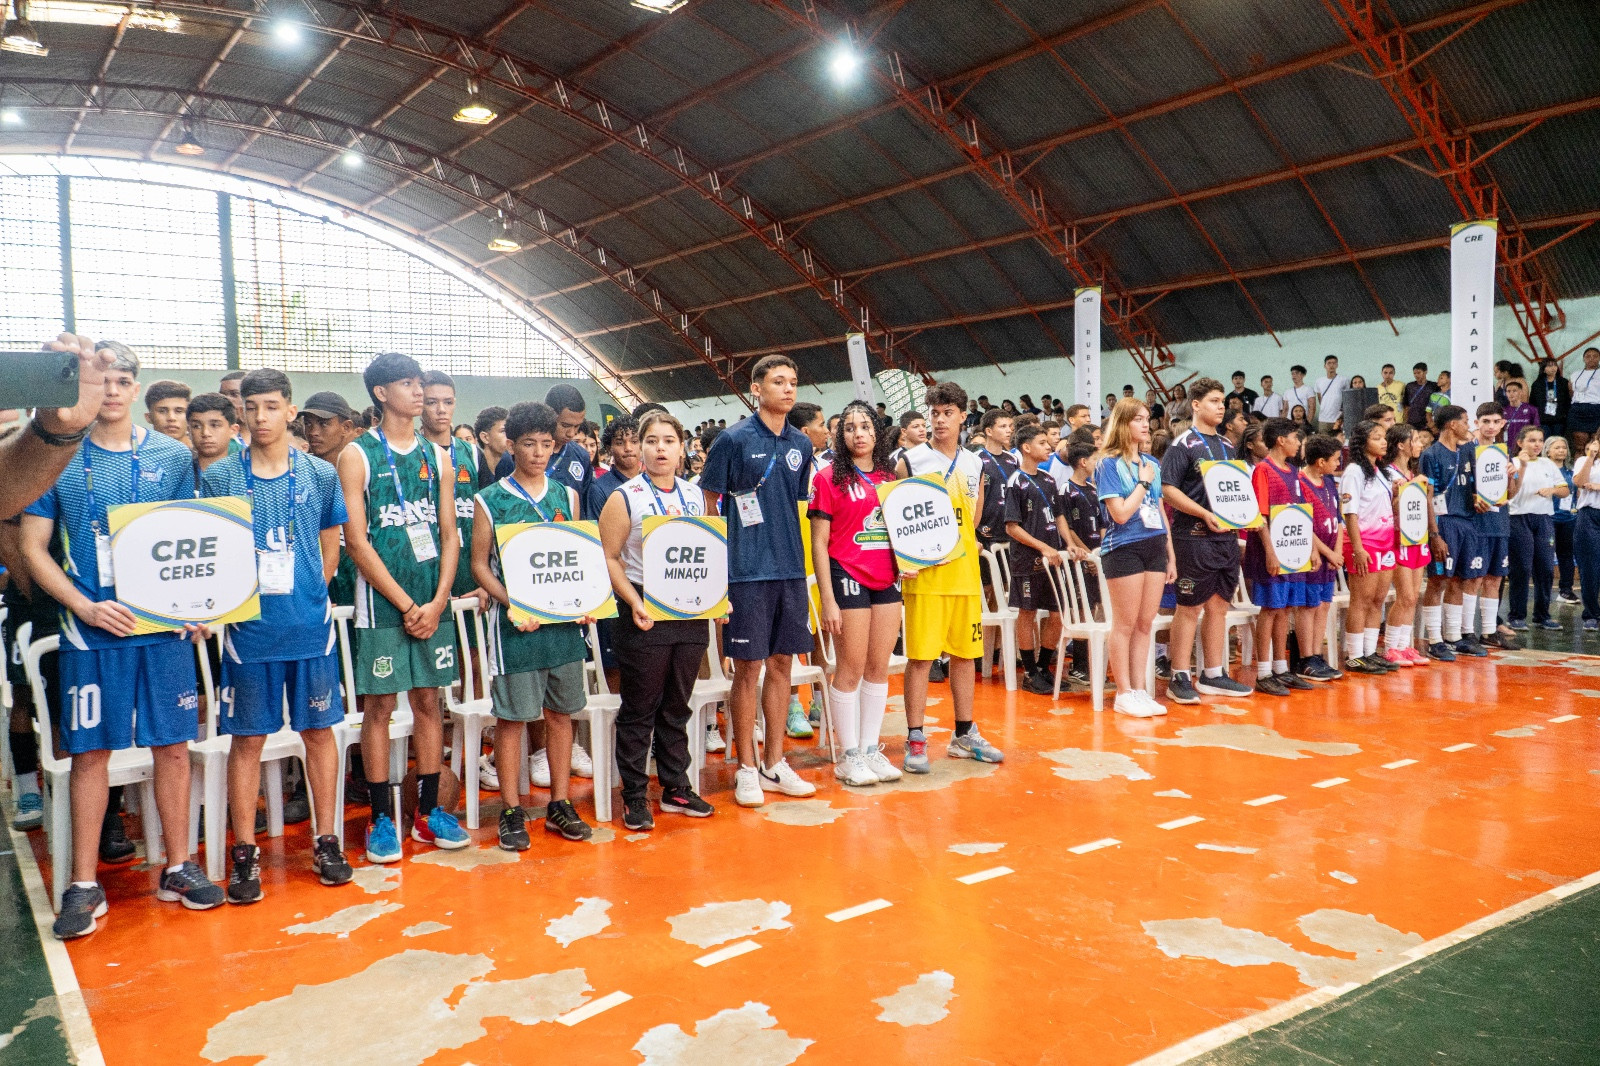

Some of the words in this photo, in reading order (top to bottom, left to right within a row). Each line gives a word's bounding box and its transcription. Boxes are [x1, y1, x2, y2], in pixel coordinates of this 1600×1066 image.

[1464, 234, 1483, 243] CRE
[1470, 294, 1478, 402] ITAPACI
[1485, 462, 1500, 474] CRE
[1218, 480, 1241, 492] CRE
[1215, 494, 1251, 503] RUBIATABA
[1407, 500, 1420, 511] CRE
[901, 500, 935, 521] CRE
[896, 515, 950, 538] PORANGATU
[1282, 524, 1303, 537] CRE
[151, 536, 218, 562] CRE
[1275, 537, 1288, 548] SÃO
[1289, 538, 1309, 547] MIGUEL
[529, 550, 579, 569] CRE
[665, 546, 707, 564] CRE
[160, 562, 216, 581] CERES
[532, 570, 584, 585] ITAPACI
[664, 567, 708, 582] MINAÇU
[434, 645, 454, 670] 25
[67, 683, 101, 731] 10
